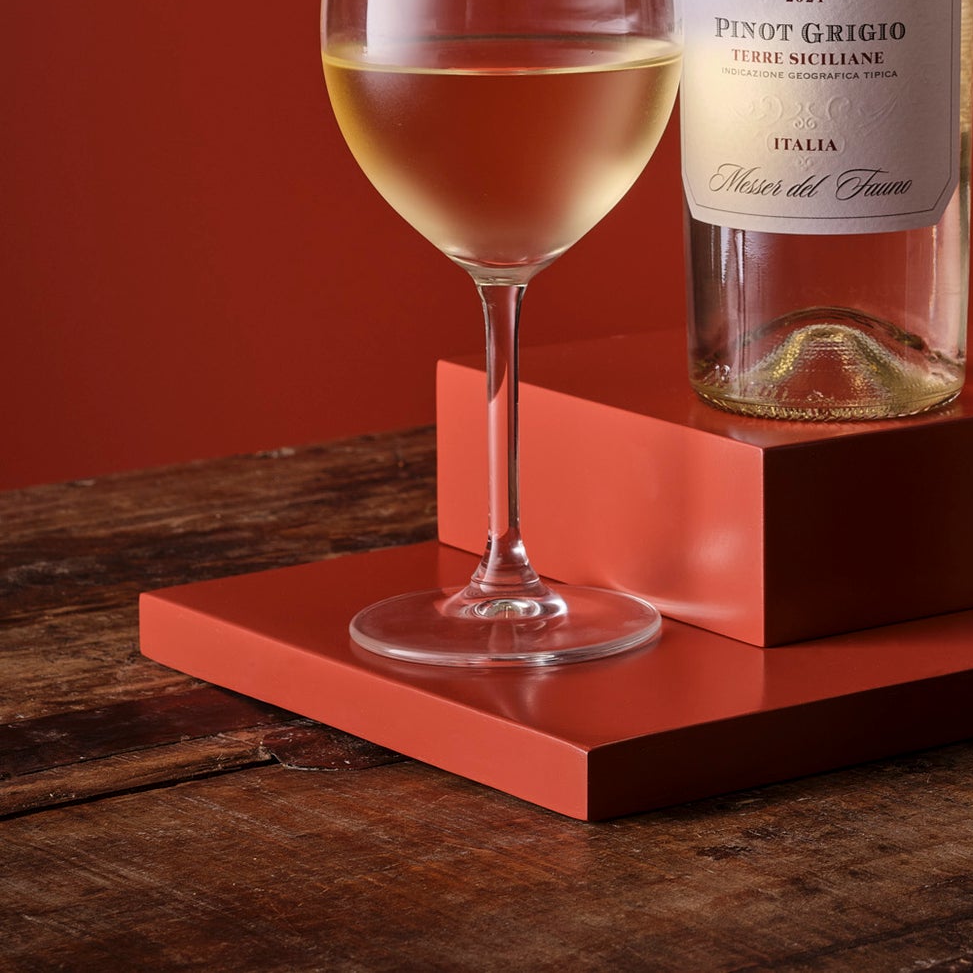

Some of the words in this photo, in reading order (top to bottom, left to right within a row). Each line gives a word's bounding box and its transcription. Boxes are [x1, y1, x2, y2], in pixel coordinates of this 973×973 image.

[714, 16, 794, 42] PINOT
[801, 21, 907, 44] GRIGIO
[731, 48, 784, 65] TERRE
[788, 51, 885, 66] SICILIANE
[721, 66, 785, 80] INDICAZIONE
[787, 71, 860, 80] GEOGRAFICA
[863, 70, 899, 78] TIPICA
[773, 137, 838, 152] ITALIA
[708, 163, 783, 198] Messer
[786, 174, 831, 199] del
[835, 167, 914, 202] Fauno
